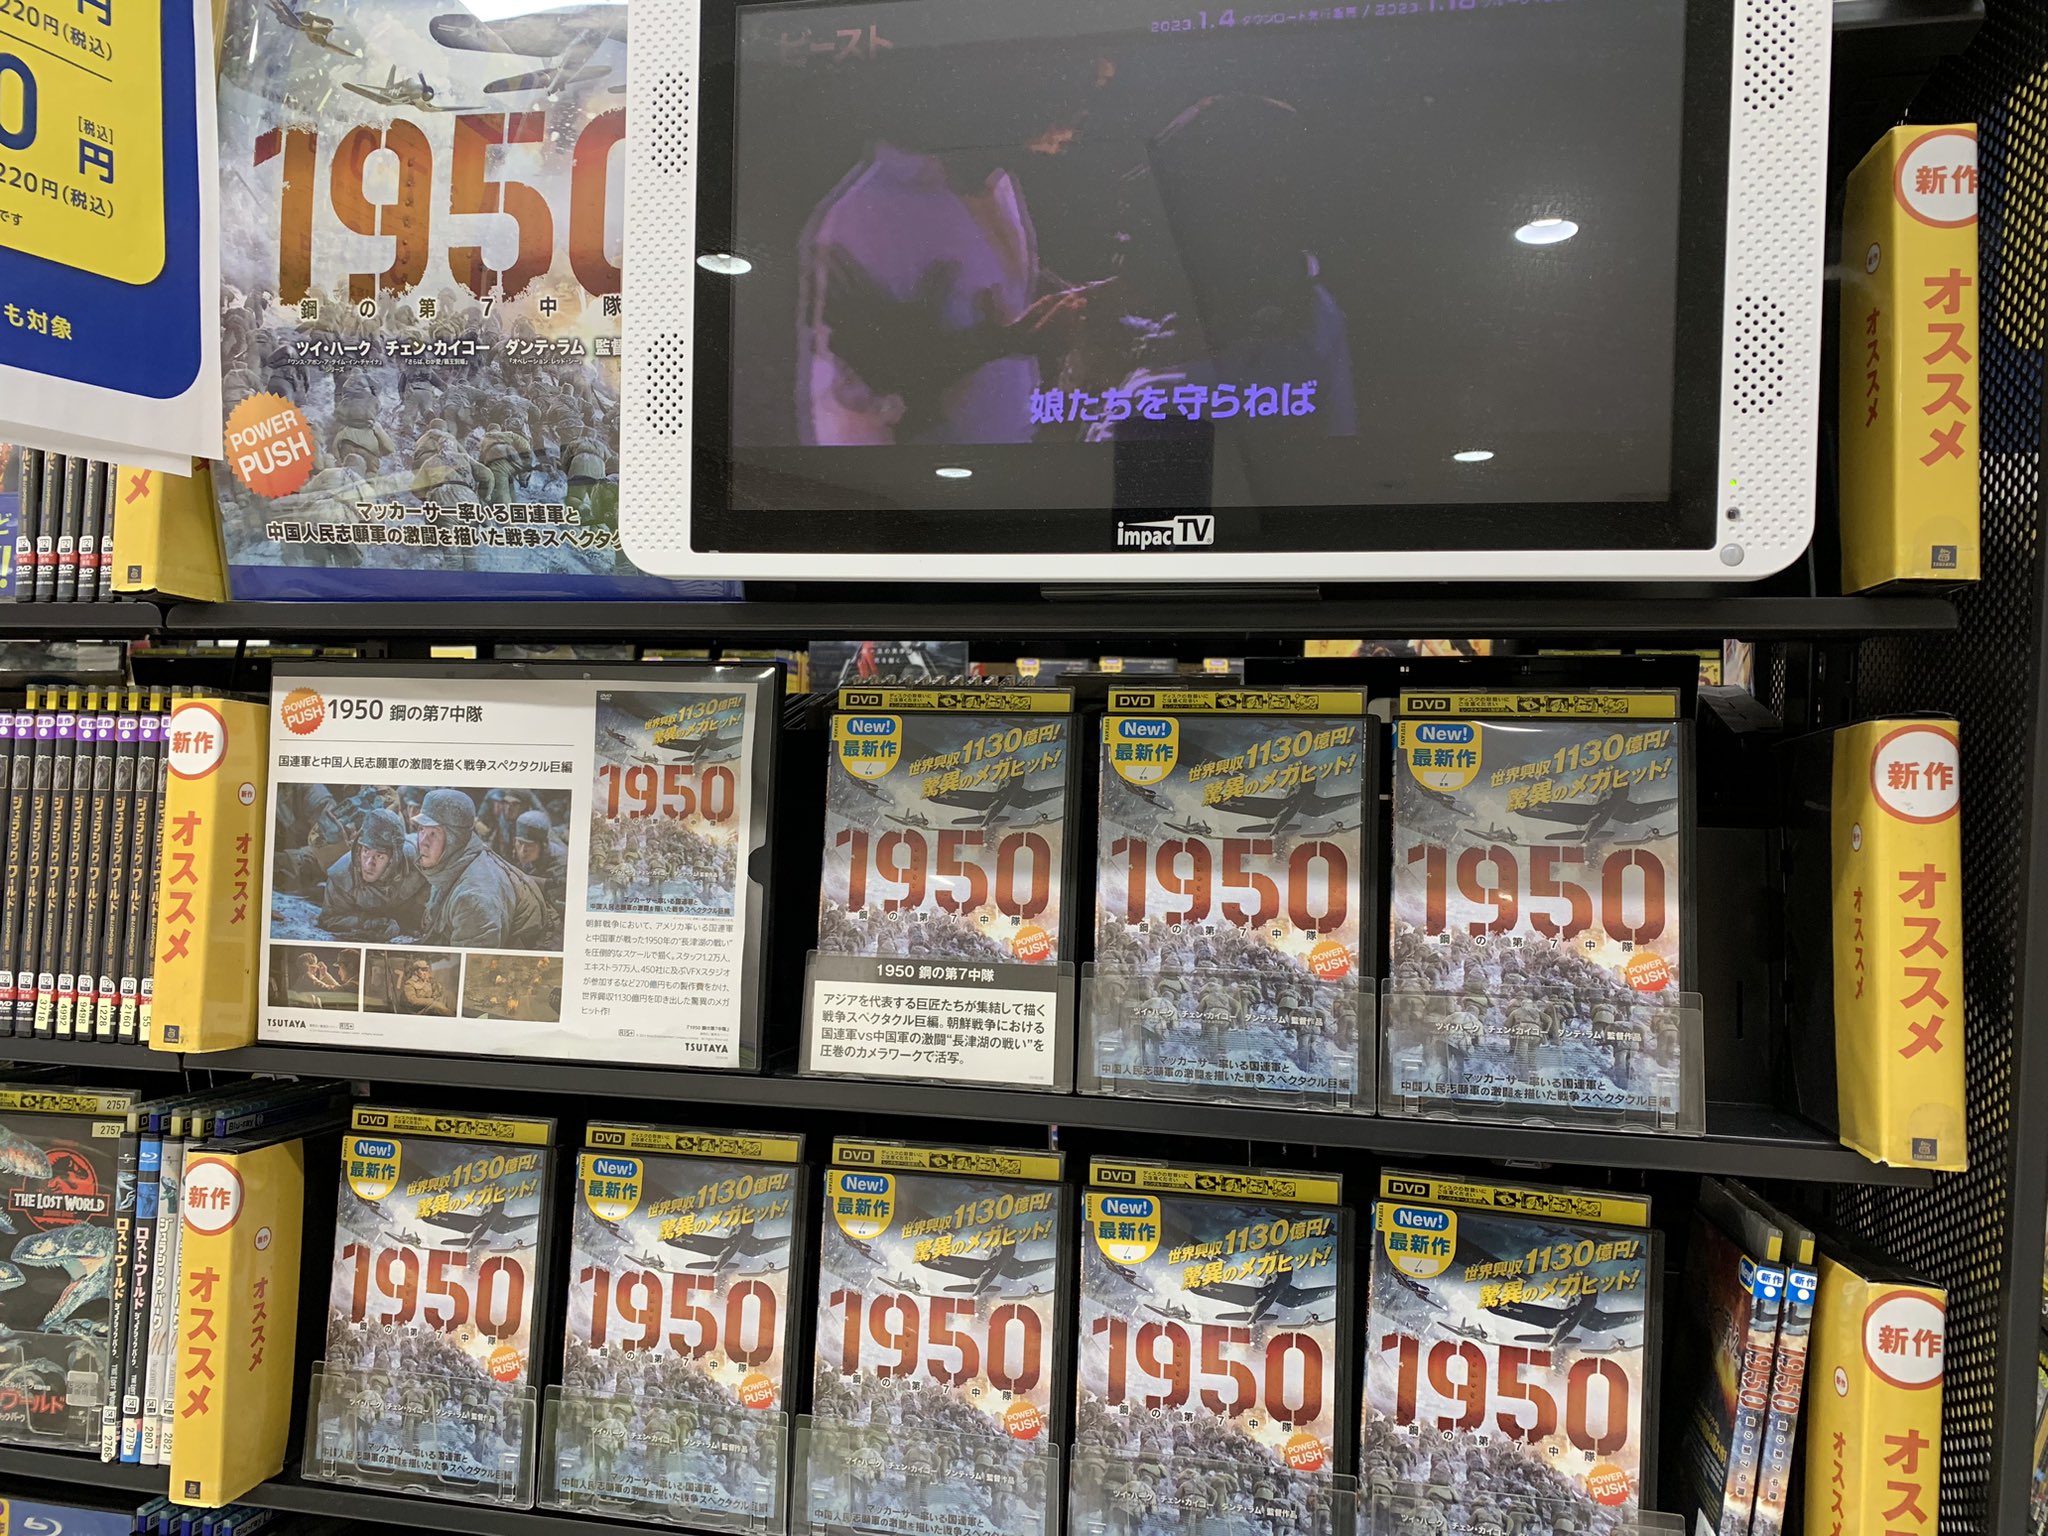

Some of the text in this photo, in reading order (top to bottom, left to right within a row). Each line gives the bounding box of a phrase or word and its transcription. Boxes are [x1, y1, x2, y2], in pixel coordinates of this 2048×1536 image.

[1915, 164, 1978, 195] 新作
[4, 303, 72, 341] も対象
[297, 340, 371, 356] ツイ・ハーク
[385, 340, 490, 356] チェン・カイコー
[506, 338, 585, 355] ダンテ・ラム
[1919, 268, 1973, 467] オススメ
[1030, 379, 1317, 425] 娘たちを守らねば
[230, 409, 298, 451] POWER
[237, 431, 311, 483] PUSH
[356, 502, 581, 525] マッカーサー率いる国連軍と
[284, 695, 319, 714] POWER
[327, 698, 483, 723] 1950 鋼の第7中隊
[850, 695, 878, 705] DVD
[1120, 696, 1150, 706] DVD
[1412, 699, 1446, 710] DVD
[287, 706, 323, 727] PUSH
[853, 719, 890, 733] New!
[1125, 722, 1166, 736] New!
[1423, 727, 1467, 740] New!
[172, 730, 214, 754] 新作
[843, 740, 896, 757] 最新作
[908, 724, 1061, 777] 世界興収1130億円!
[1115, 743, 1173, 762] 最新作
[278, 755, 573, 774] 国連軍と中国人民志願軍の激闘を描く戦争スペクタクル巨編
[1188, 727, 1356, 783] 世界興収1130億円!
[1412, 748, 1476, 768] 最新作
[1491, 730, 1670, 787] 世界興収1130億円!
[921, 751, 1061, 799] 驚異のメガヒット!
[1202, 754, 1356, 806] 驚異のメガヒット!
[1506, 757, 1672, 812] 驚異のメガヒット!
[1888, 761, 1953, 791] 新作
[599, 765, 734, 822] 1950
[229, 833, 252, 924] オススメ
[836, 829, 1051, 919] 1950
[1112, 837, 1348, 934] 1950
[161, 810, 201, 963] オススメ
[1407, 844, 1665, 945] 1950
[1016, 932, 1044, 947] POWER
[1018, 941, 1049, 958] PUSH
[1312, 948, 1343, 963] POWER
[1315, 957, 1349, 974] PUSH
[1898, 863, 1950, 1060] オススメ
[877, 964, 995, 982] 1950 鋼の第7中隊
[1628, 960, 1663, 976] POWER
[1632, 969, 1667, 987] PUSH
[823, 993, 1046, 1017] アジアを代表する巨匠たちが集結して描く
[267, 1018, 306, 1029] TSUTAYA
[822, 1010, 1045, 1034] 戦争スペクタクル巨編。朝鮮戦争における
[685, 1043, 729, 1053] TSUTAYA
[820, 1044, 965, 1064] 圧巻のカメラワークで活写。
[107, 1101, 126, 1110] 2757
[101, 1126, 120, 1135] 2757
[358, 1144, 391, 1157] New!
[842, 1150, 871, 1161] DVD
[350, 1161, 395, 1180] 最新作
[406, 1154, 538, 1197] 世界興収1130億円!
[597, 1160, 633, 1175] New!
[1101, 1171, 1132, 1182] DVD
[588, 1182, 637, 1200] 最新作
[846, 1176, 884, 1191] New!
[1393, 1183, 1426, 1195] DVD
[14, 1193, 105, 1211] THE LOST WORLD
[188, 1186, 231, 1210] 新作
[415, 1180, 537, 1219] 驚異のメガヒット!
[648, 1173, 789, 1219] 世界興収1130億円!
[837, 1197, 890, 1218] 最新作
[1107, 1200, 1147, 1215] New!
[657, 1200, 789, 1243] 驚異のメガヒット!
[901, 1193, 1053, 1239] 世界興収1130億円!
[1399, 1211, 1443, 1228] New!
[912, 1220, 1053, 1264] 驚異のメガヒット!
[1099, 1222, 1155, 1241] 最新作
[1168, 1218, 1330, 1266] 世界興収1130億円!
[1389, 1233, 1450, 1256] 最新作
[1180, 1246, 1331, 1290] 驚異のメガヒット!
[1464, 1240, 1639, 1283] 世界興収1130億円!
[1477, 1269, 1640, 1310] 驚異のメガヒット!
[1761, 1272, 1783, 1285] 新作
[1795, 1276, 1816, 1288] 新作
[343, 1243, 525, 1339] 1950
[248, 1277, 269, 1372] オススメ
[580, 1266, 777, 1366] 1950
[181, 1267, 220, 1420] オススメ
[830, 1288, 1042, 1394] 1950
[1879, 1324, 1942, 1359] 新作
[492, 1361, 521, 1376] PUSH
[1092, 1316, 1323, 1426] 1950
[1740, 1342, 1773, 1410] 1950
[1772, 1346, 1805, 1414] 1950
[744, 1388, 773, 1404] PUSH
[1381, 1332, 1629, 1455] 1950
[1007, 1409, 1036, 1422] POWER
[1009, 1418, 1040, 1434] PUSH
[104, 1434, 113, 1458] 2768
[125, 1427, 135, 1450] 2779
[145, 1426, 154, 1449] 2807
[164, 1433, 173, 1454] 2821
[1287, 1440, 1318, 1454] POWER
[1289, 1449, 1323, 1467] PUSH
[1590, 1472, 1624, 1487] POWER
[1592, 1481, 1628, 1498] PUSH
